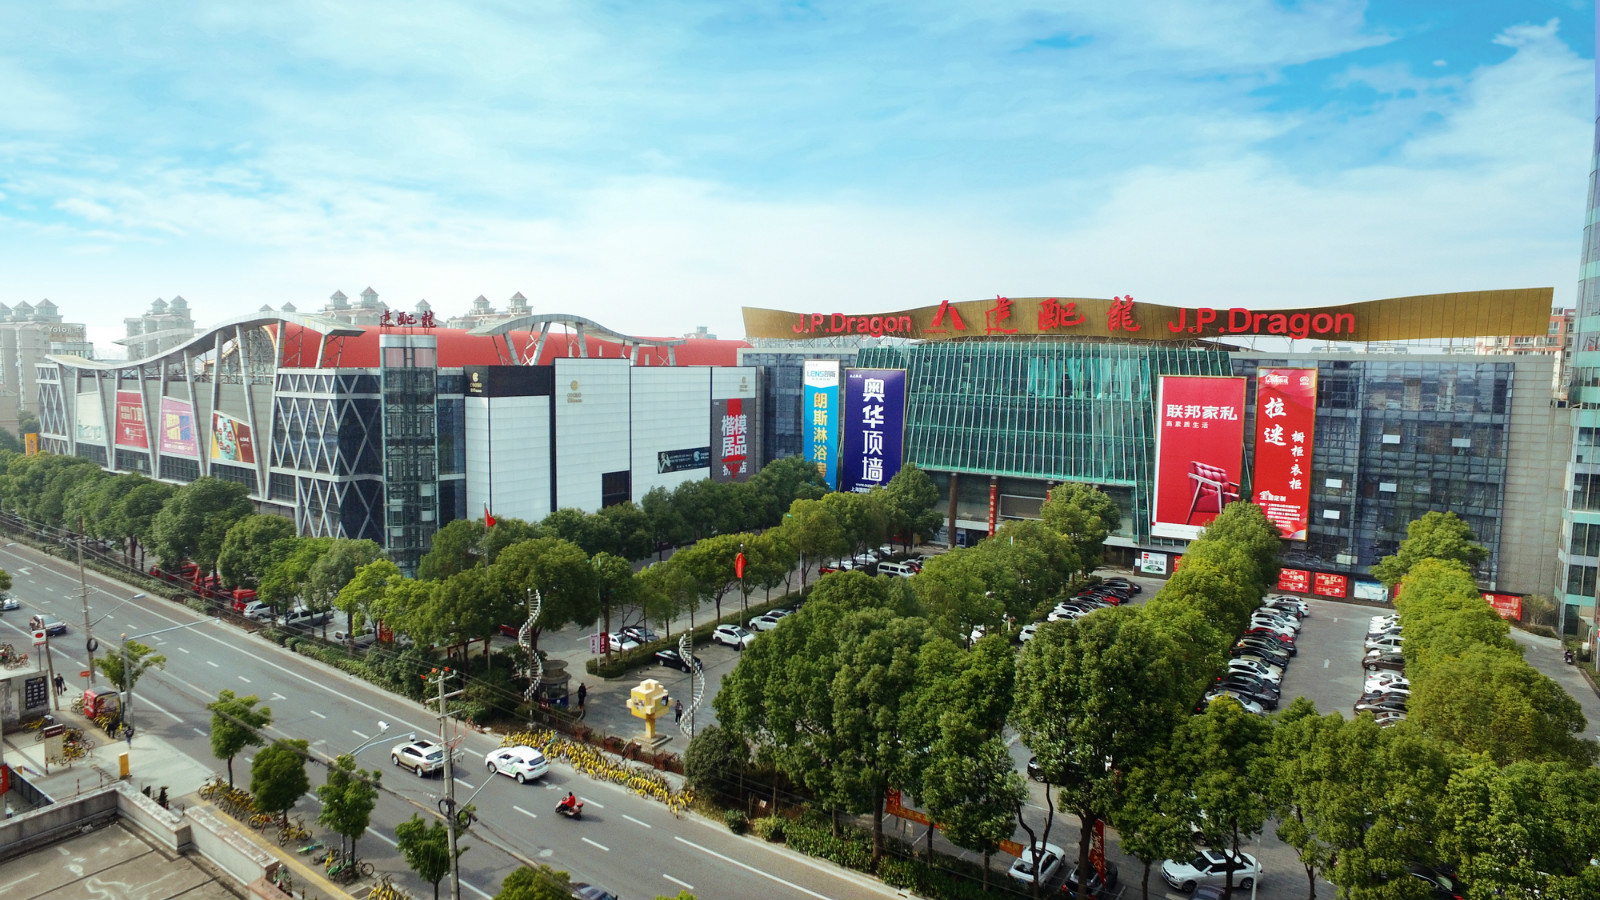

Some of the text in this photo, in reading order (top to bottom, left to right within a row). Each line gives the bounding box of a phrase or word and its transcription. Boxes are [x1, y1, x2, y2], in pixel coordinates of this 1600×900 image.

[793, 313, 912, 337] J.P.Dragon
[1168, 308, 1355, 339] J.P.Dragon
[1166, 404, 1238, 421] 联邦家私
[1264, 397, 1287, 447] 拉迷
[862, 378, 885, 481] 奥华顶墙
